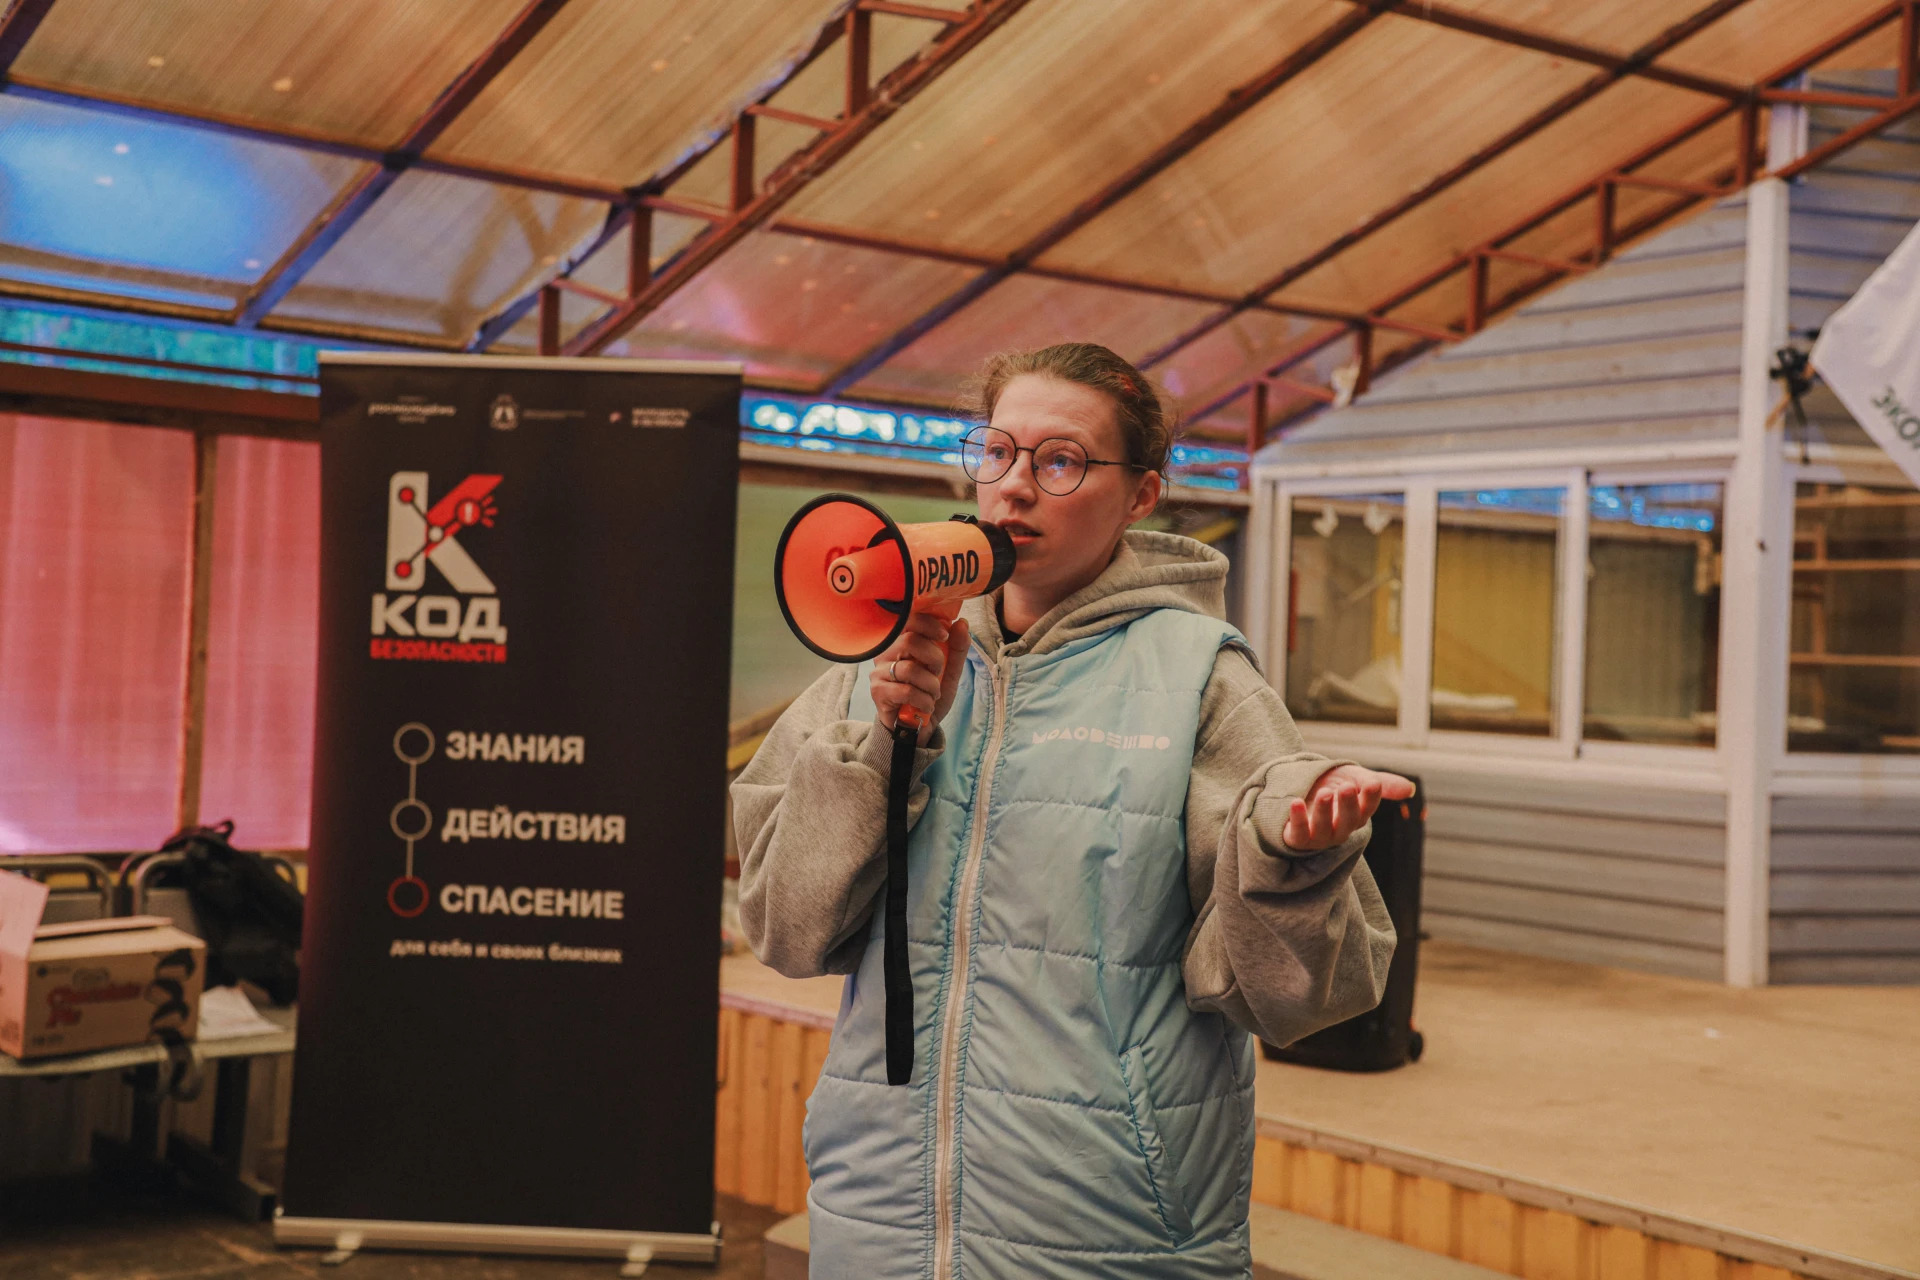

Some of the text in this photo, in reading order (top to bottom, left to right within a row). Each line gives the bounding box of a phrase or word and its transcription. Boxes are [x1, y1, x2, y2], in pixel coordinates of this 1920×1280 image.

[918, 550, 979, 595] ОРАЛО
[371, 593, 507, 644] КОД
[370, 639, 507, 664] БЕЗОПАСНОСТИ
[445, 731, 585, 764] ЗНАНИЯ
[441, 805, 626, 844] ДЕЙСТВИЯ
[440, 884, 624, 919] СПАСЕНИЕ
[390, 939, 426, 957] для
[428, 938, 472, 957] себя
